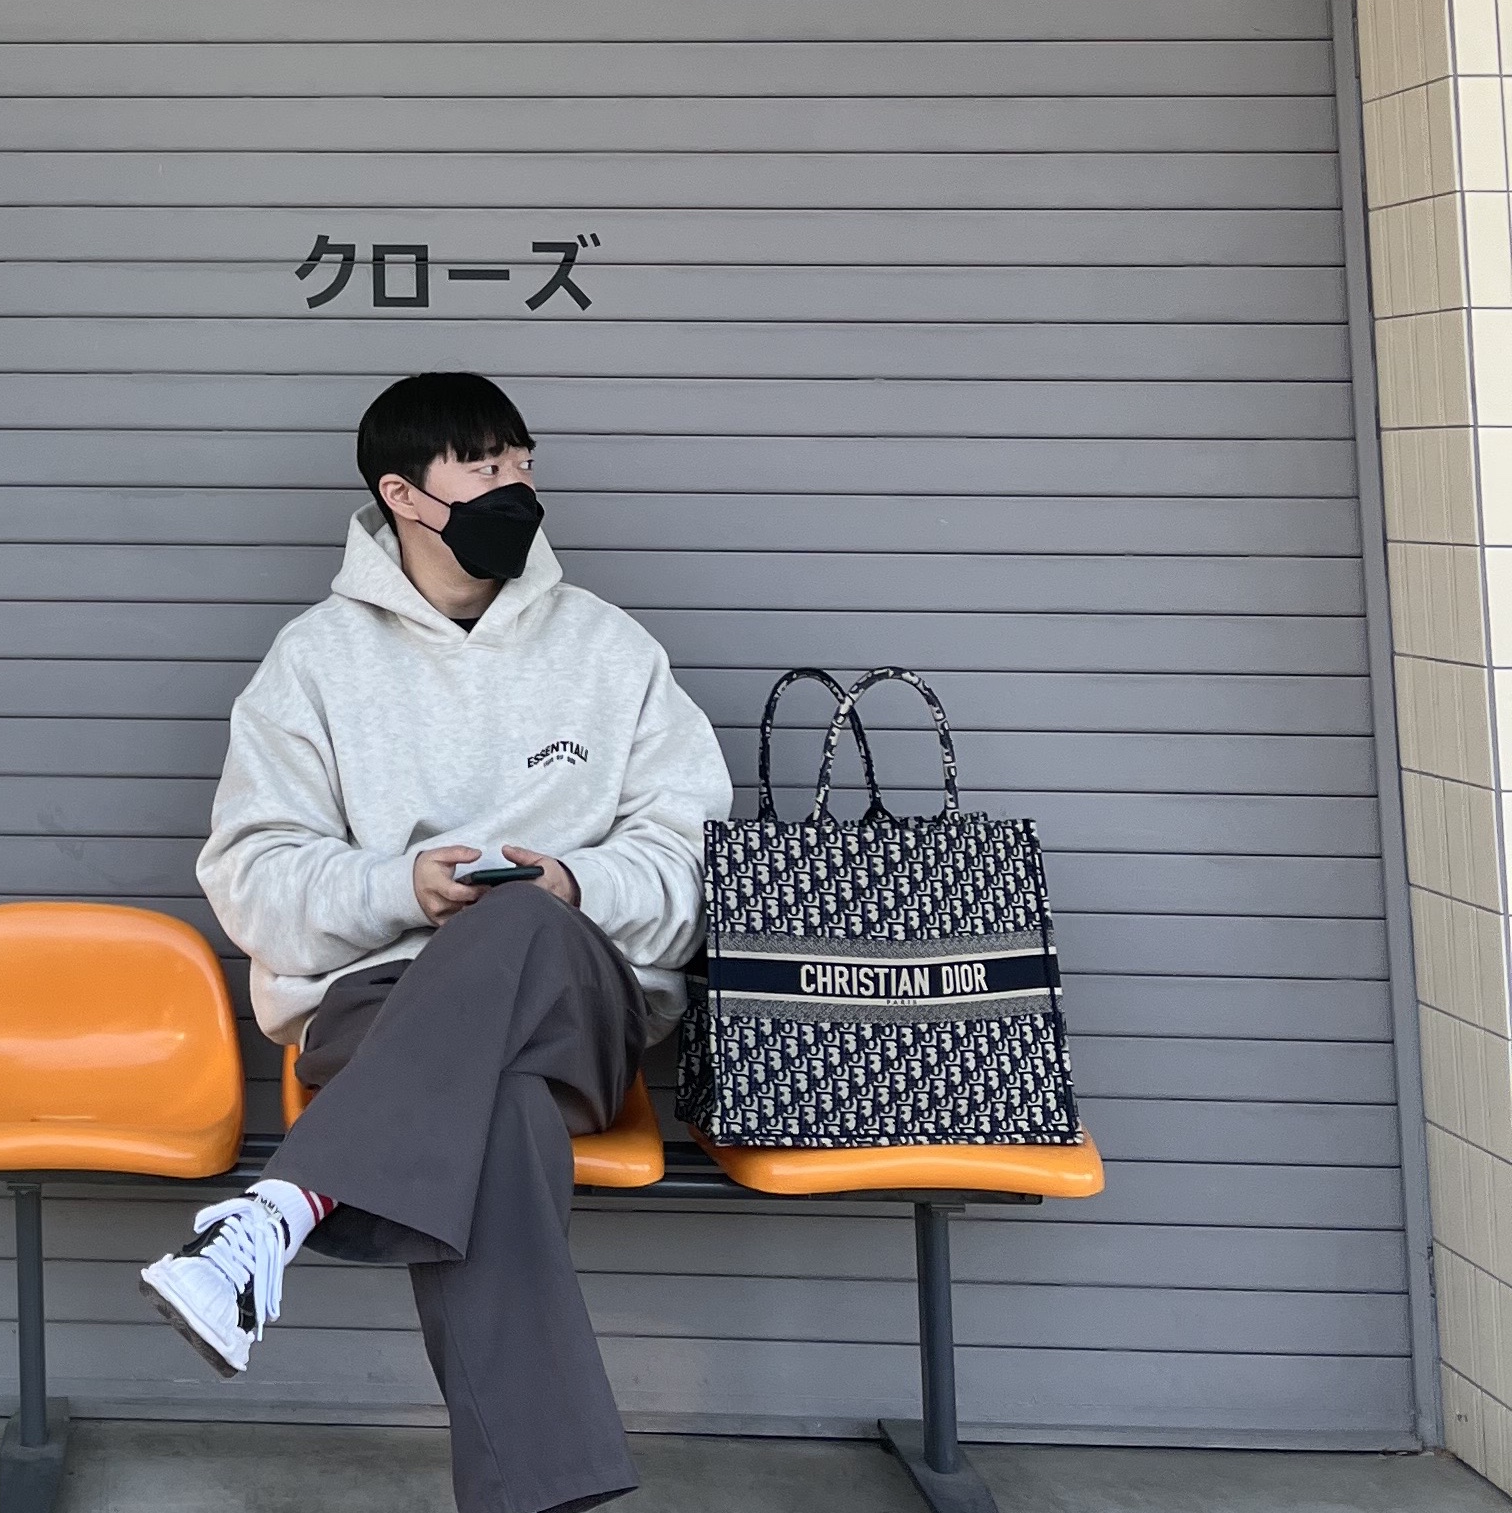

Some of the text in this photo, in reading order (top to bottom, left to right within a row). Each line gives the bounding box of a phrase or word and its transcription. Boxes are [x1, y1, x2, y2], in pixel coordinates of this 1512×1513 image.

[295, 233, 601, 311] クローズ
[800, 962, 989, 997] CHRISTIAN DIOR
